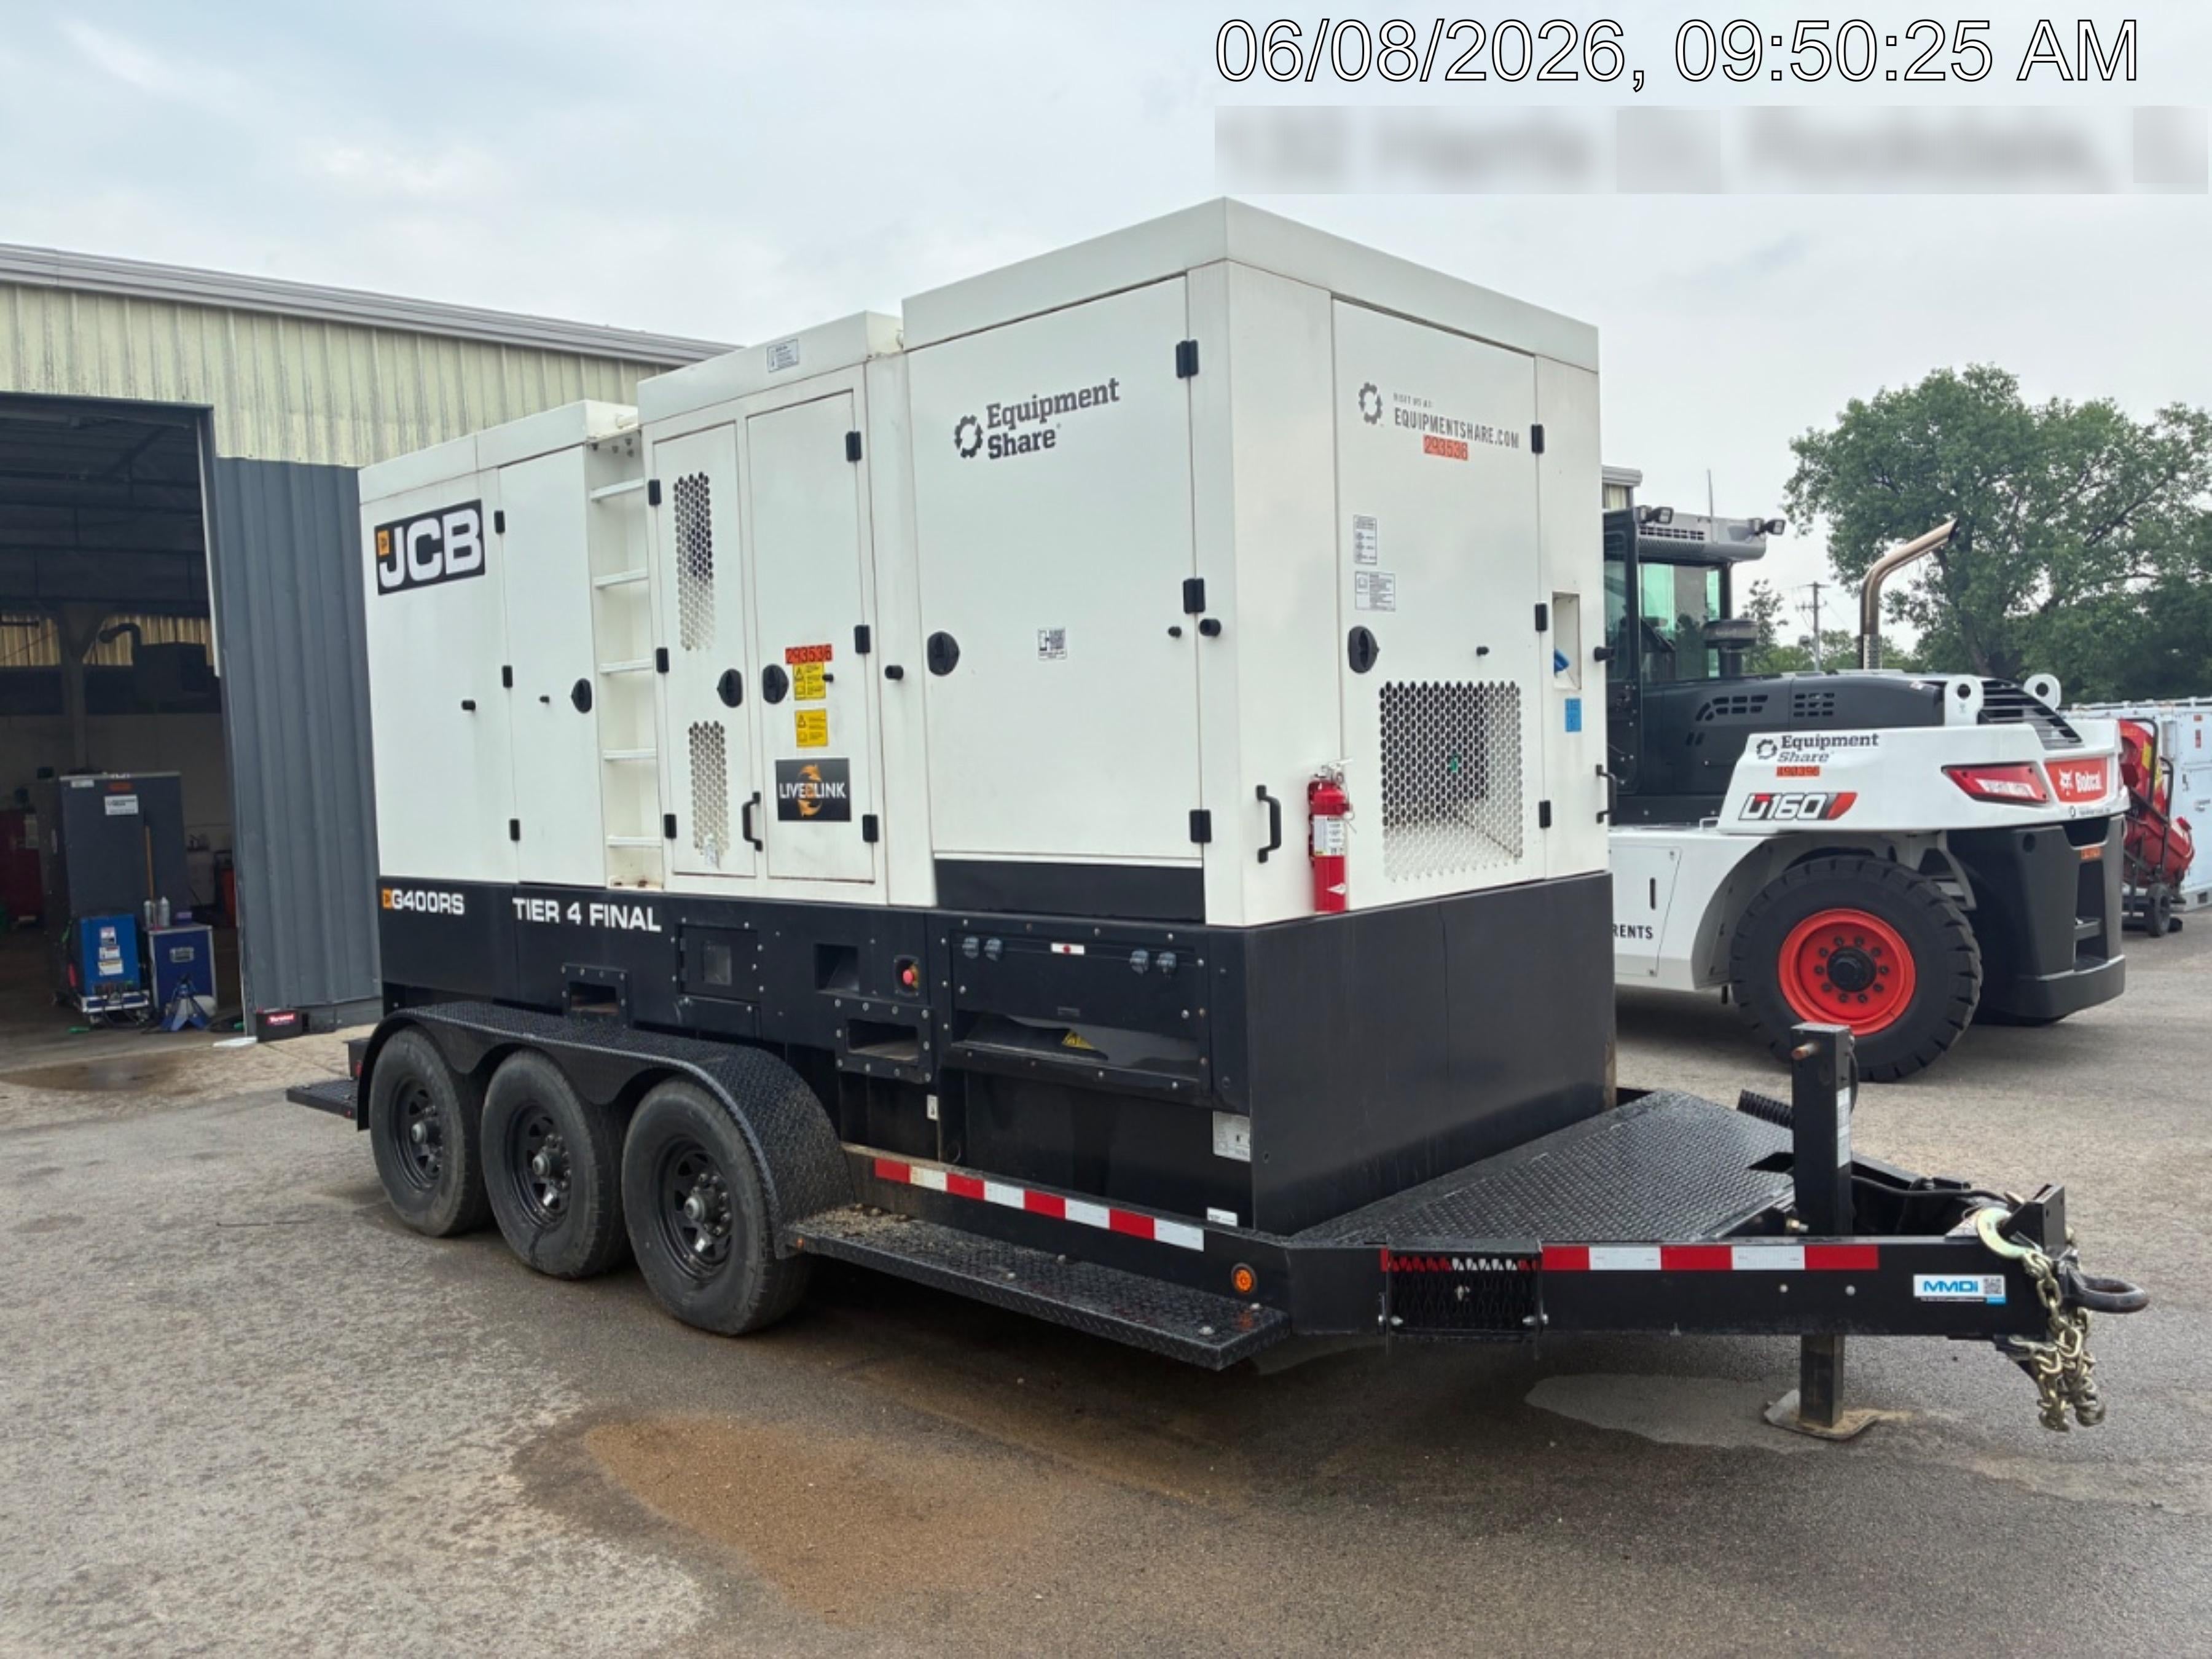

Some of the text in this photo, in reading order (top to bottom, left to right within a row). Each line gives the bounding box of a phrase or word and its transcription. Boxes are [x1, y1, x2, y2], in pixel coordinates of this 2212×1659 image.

[986, 377, 1121, 430] Equipment
[987, 428, 1057, 460] Share
[1394, 407, 1520, 449] EQUIPMENTSHARE.COM
[378, 508, 482, 589] JCB
[1777, 751, 1830, 763] Share
[1781, 733, 1880, 751] Equipment
[815, 782, 847, 799] LINK
[512, 898, 662, 932] TIER 4 FINAL
